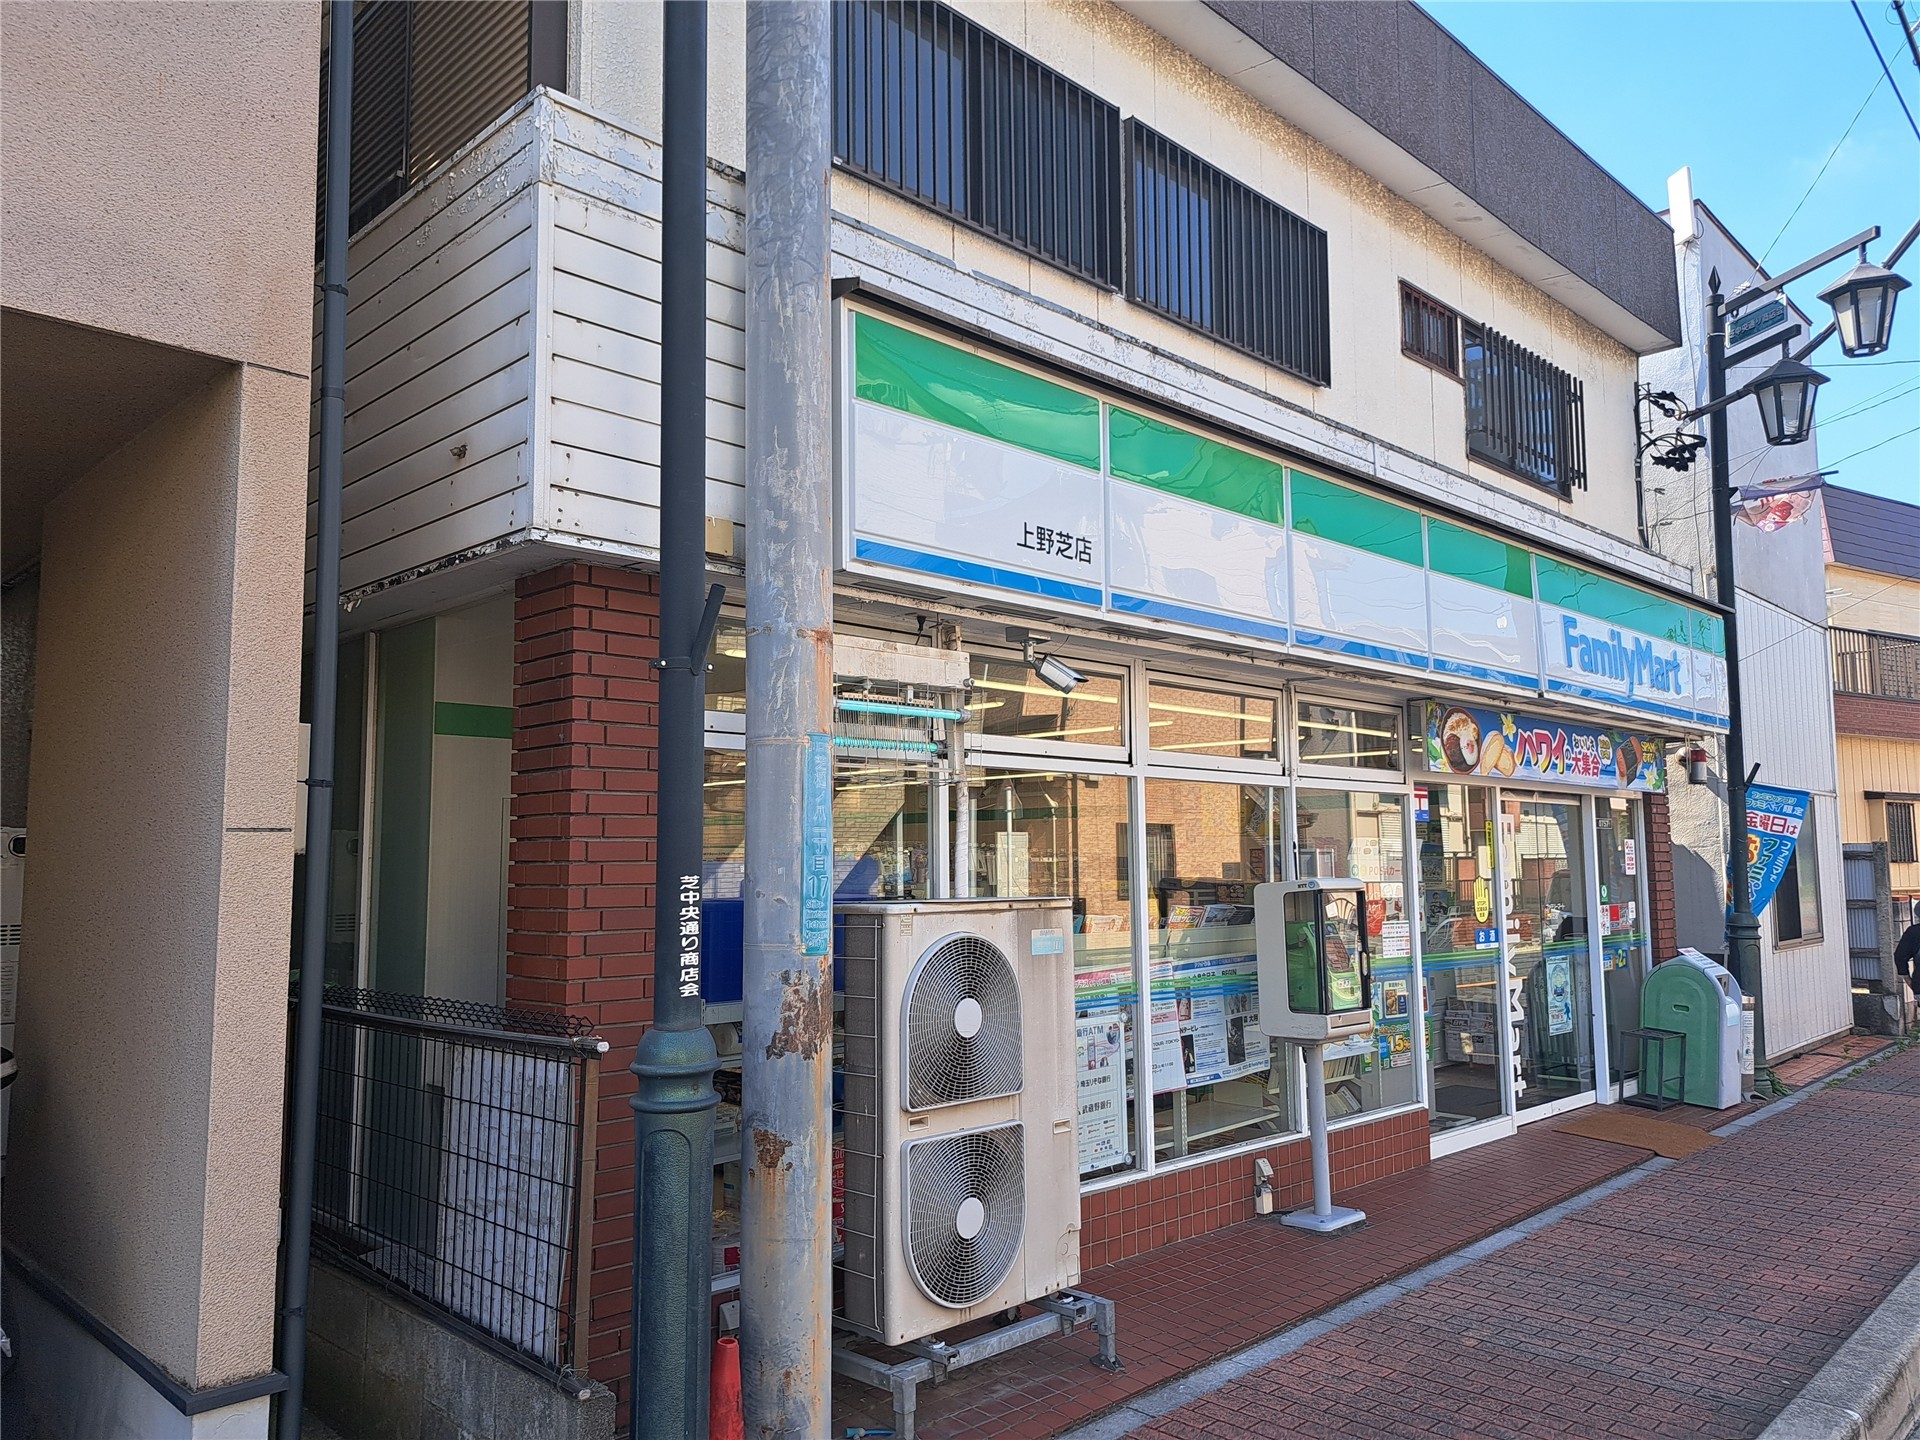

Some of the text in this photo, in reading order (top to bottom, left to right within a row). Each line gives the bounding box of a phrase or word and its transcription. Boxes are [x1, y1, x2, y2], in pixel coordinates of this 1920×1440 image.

[1017, 522, 1092, 564] 上野芝店
[1562, 614, 1682, 697] FamilyMart
[1516, 727, 1572, 775] ハワイの
[1571, 751, 1601, 778] 大集合
[1746, 811, 1798, 836] 金曜日は
[808, 875, 829, 897] 17
[679, 875, 700, 998] 芝中央通り商店会
[1082, 1099, 1112, 1114] 武蔵野銀行
